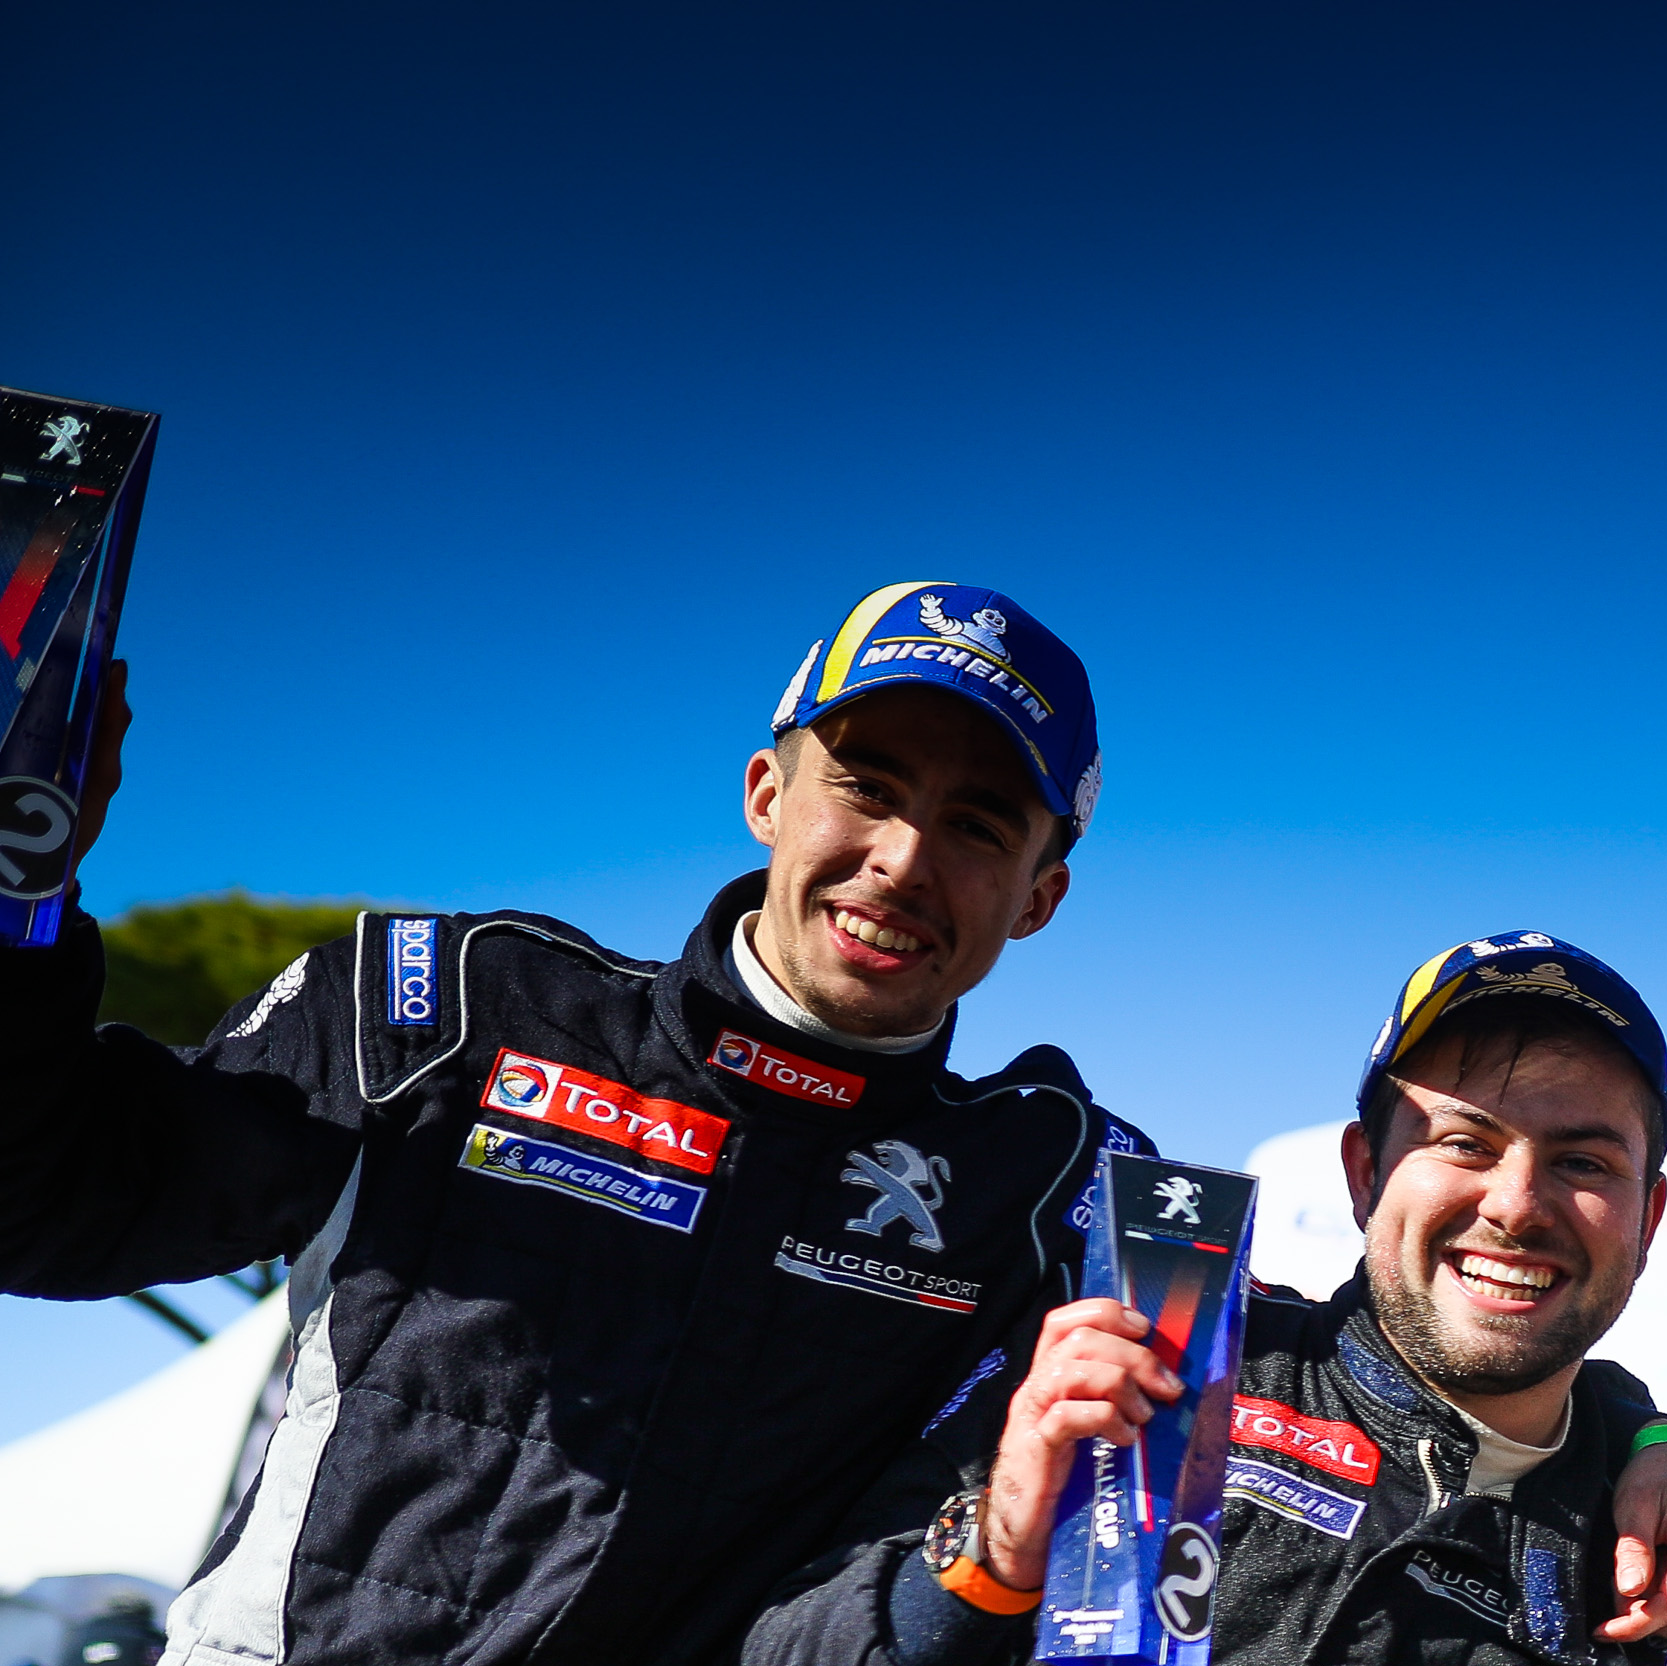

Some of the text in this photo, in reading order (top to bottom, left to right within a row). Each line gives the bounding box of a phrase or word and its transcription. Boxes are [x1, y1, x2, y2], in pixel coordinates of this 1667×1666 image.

[859, 642, 1048, 724] MICHELIN
[0, 792, 70, 887] 2
[391, 919, 433, 1020] sparco
[760, 1054, 852, 1103] TOTAL
[560, 1080, 708, 1158] TOTAL
[527, 1155, 676, 1212] MICHELIN
[781, 1235, 982, 1300] PEUGEOT SPORT
[1234, 1405, 1369, 1469] TOTAL
[1095, 1501, 1120, 1549] CUP
[1160, 1538, 1217, 1629] 2
[1414, 1550, 1510, 1610] PEUGE
